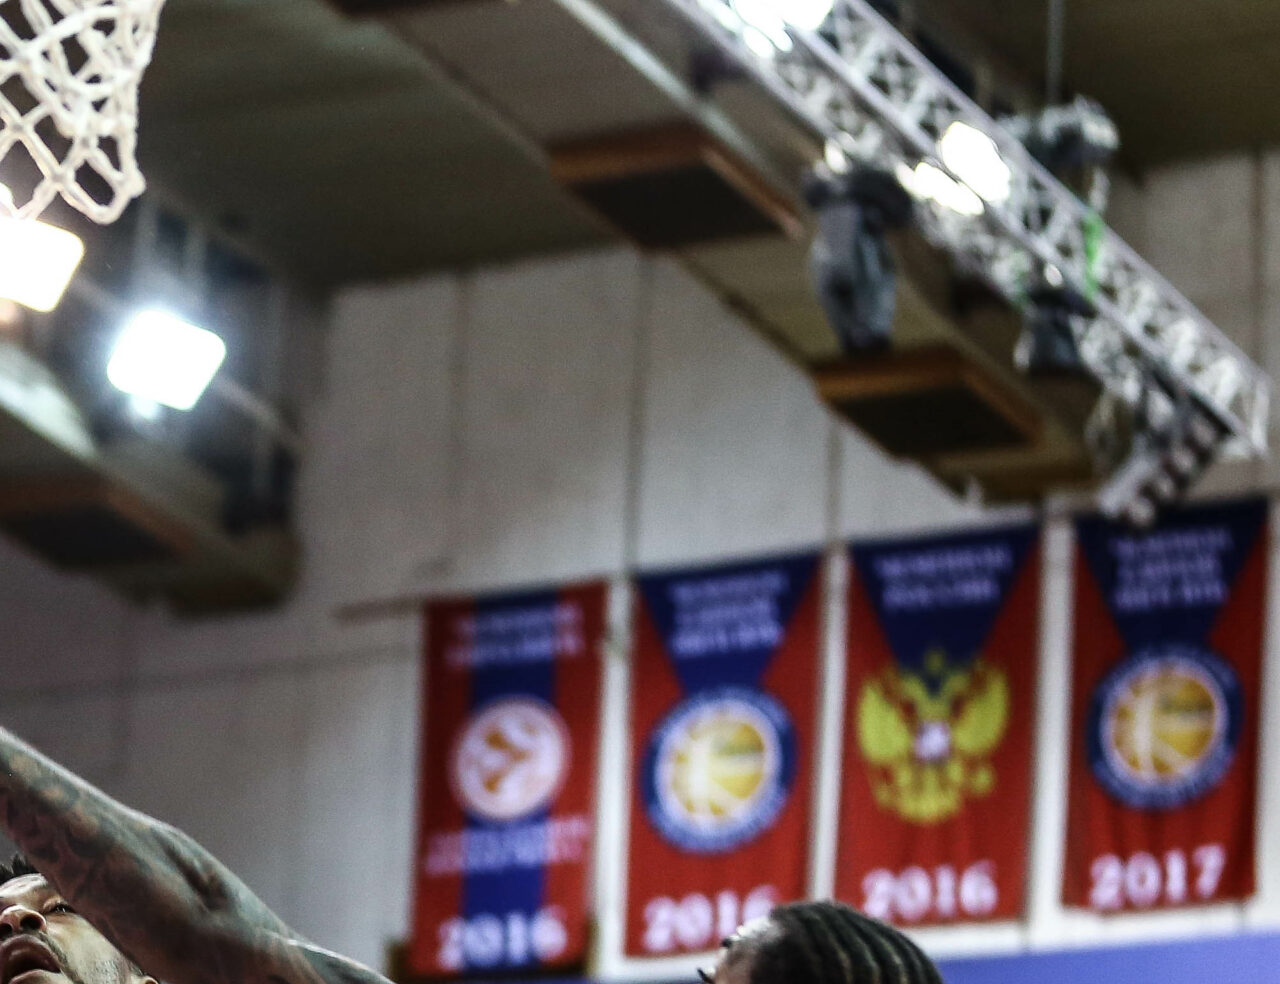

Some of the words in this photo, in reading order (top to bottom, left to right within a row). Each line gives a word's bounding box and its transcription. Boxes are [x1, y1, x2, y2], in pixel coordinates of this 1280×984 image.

[862, 859, 998, 921] 2016
[1090, 844, 1226, 910] 2017
[439, 905, 568, 970] 2016
